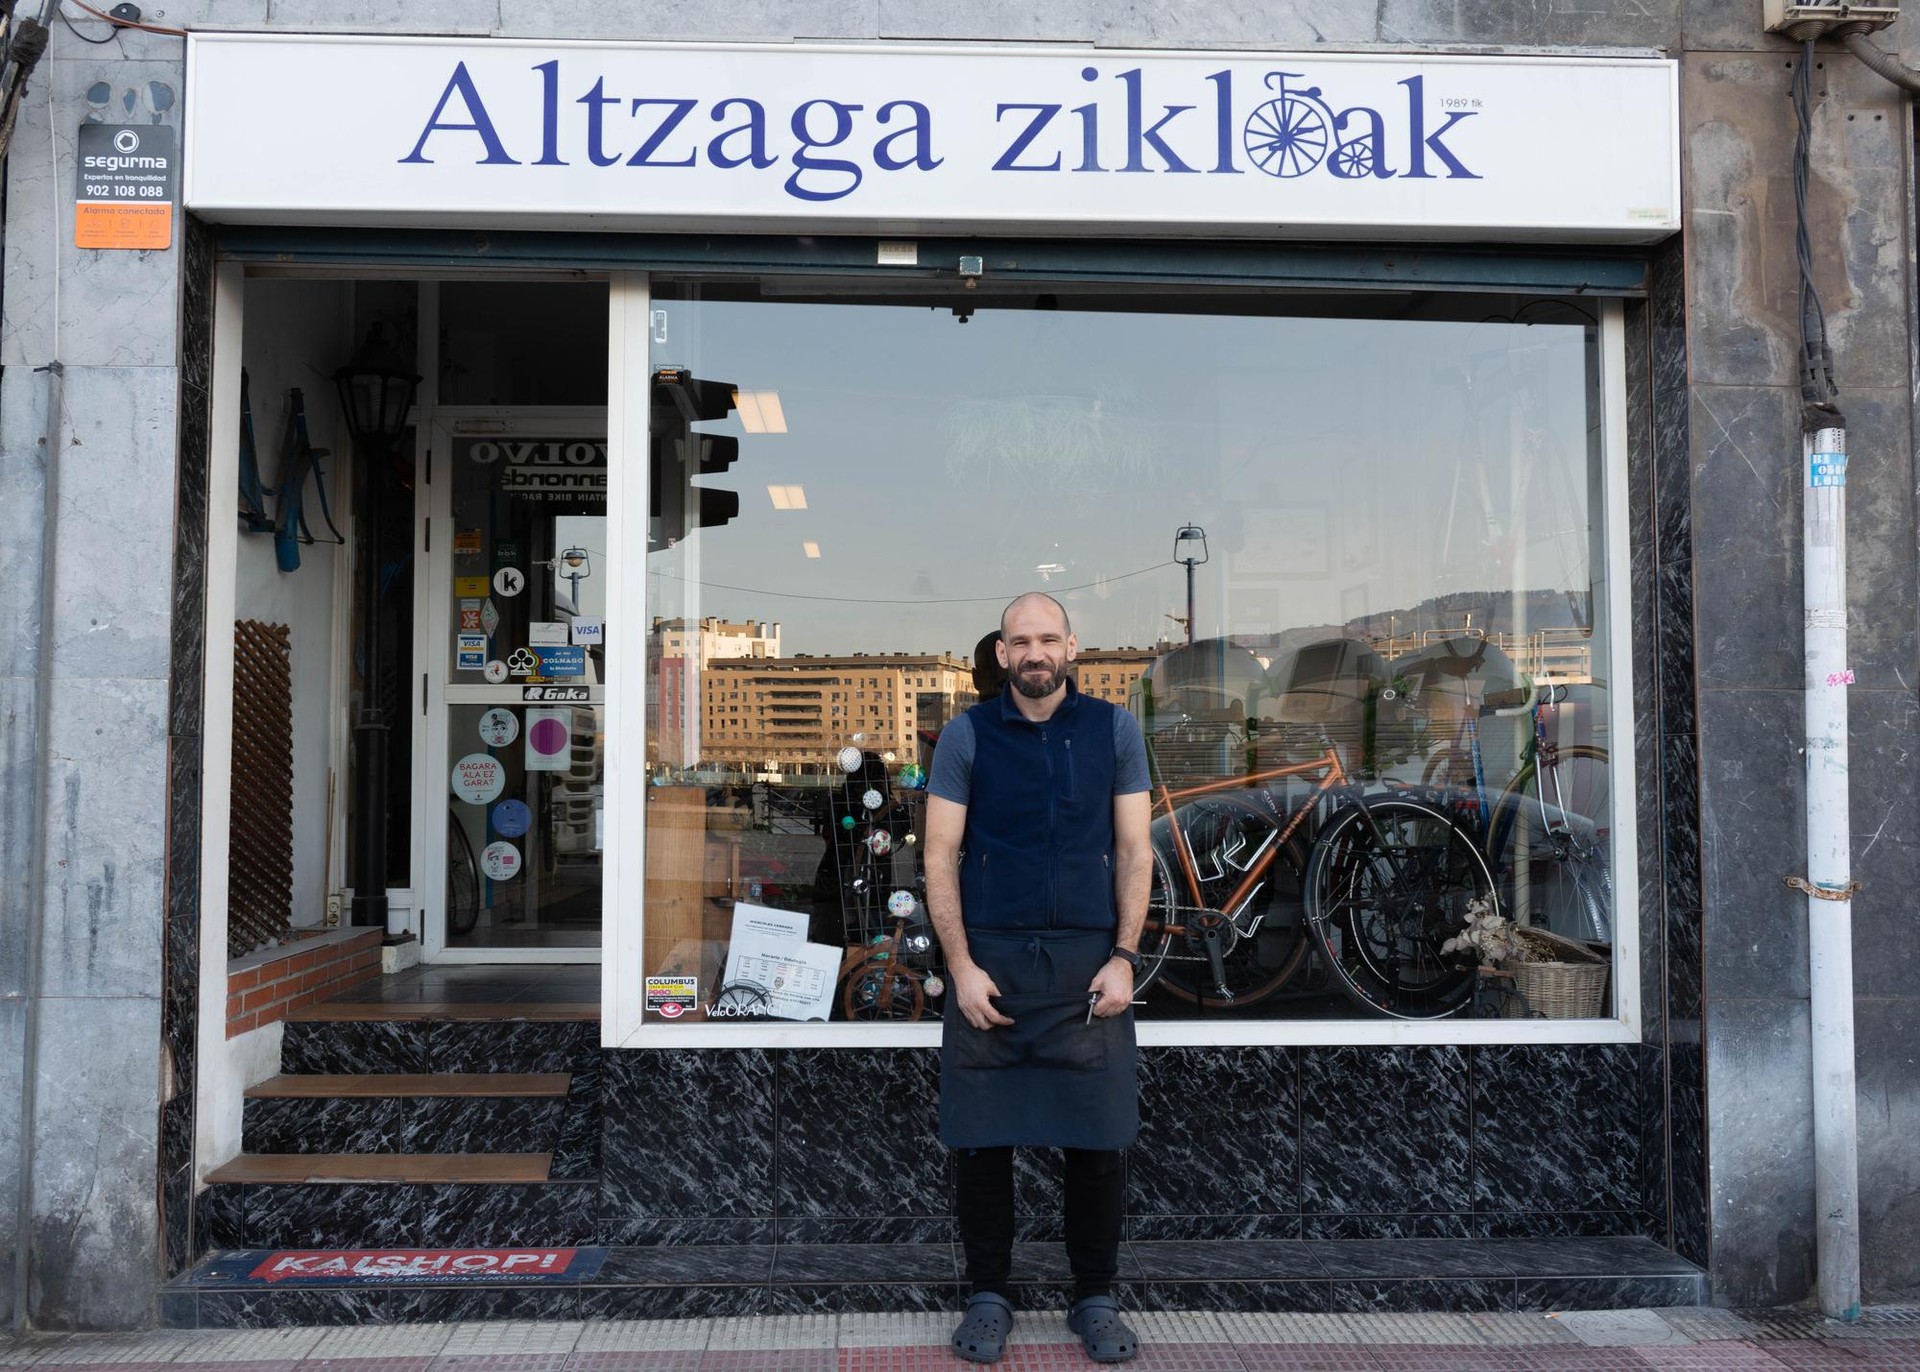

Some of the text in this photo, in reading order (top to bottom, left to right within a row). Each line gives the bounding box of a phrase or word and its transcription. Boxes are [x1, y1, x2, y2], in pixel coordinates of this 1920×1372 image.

[1440, 98, 1468, 108] 1989
[397, 59, 945, 202] Altzaga
[84, 156, 167, 171] segurma
[84, 173, 113, 182] Expertos
[125, 174, 166, 182] tranquilidad
[86, 185, 163, 197] 902 108 088
[84, 207, 165, 216] Alarma conectada
[576, 626, 600, 635] VISA
[460, 763, 497, 771] BAGARA
[463, 771, 481, 779] ALA
[463, 779, 494, 787] GARA?
[272, 1254, 558, 1273] KAISHOP!
